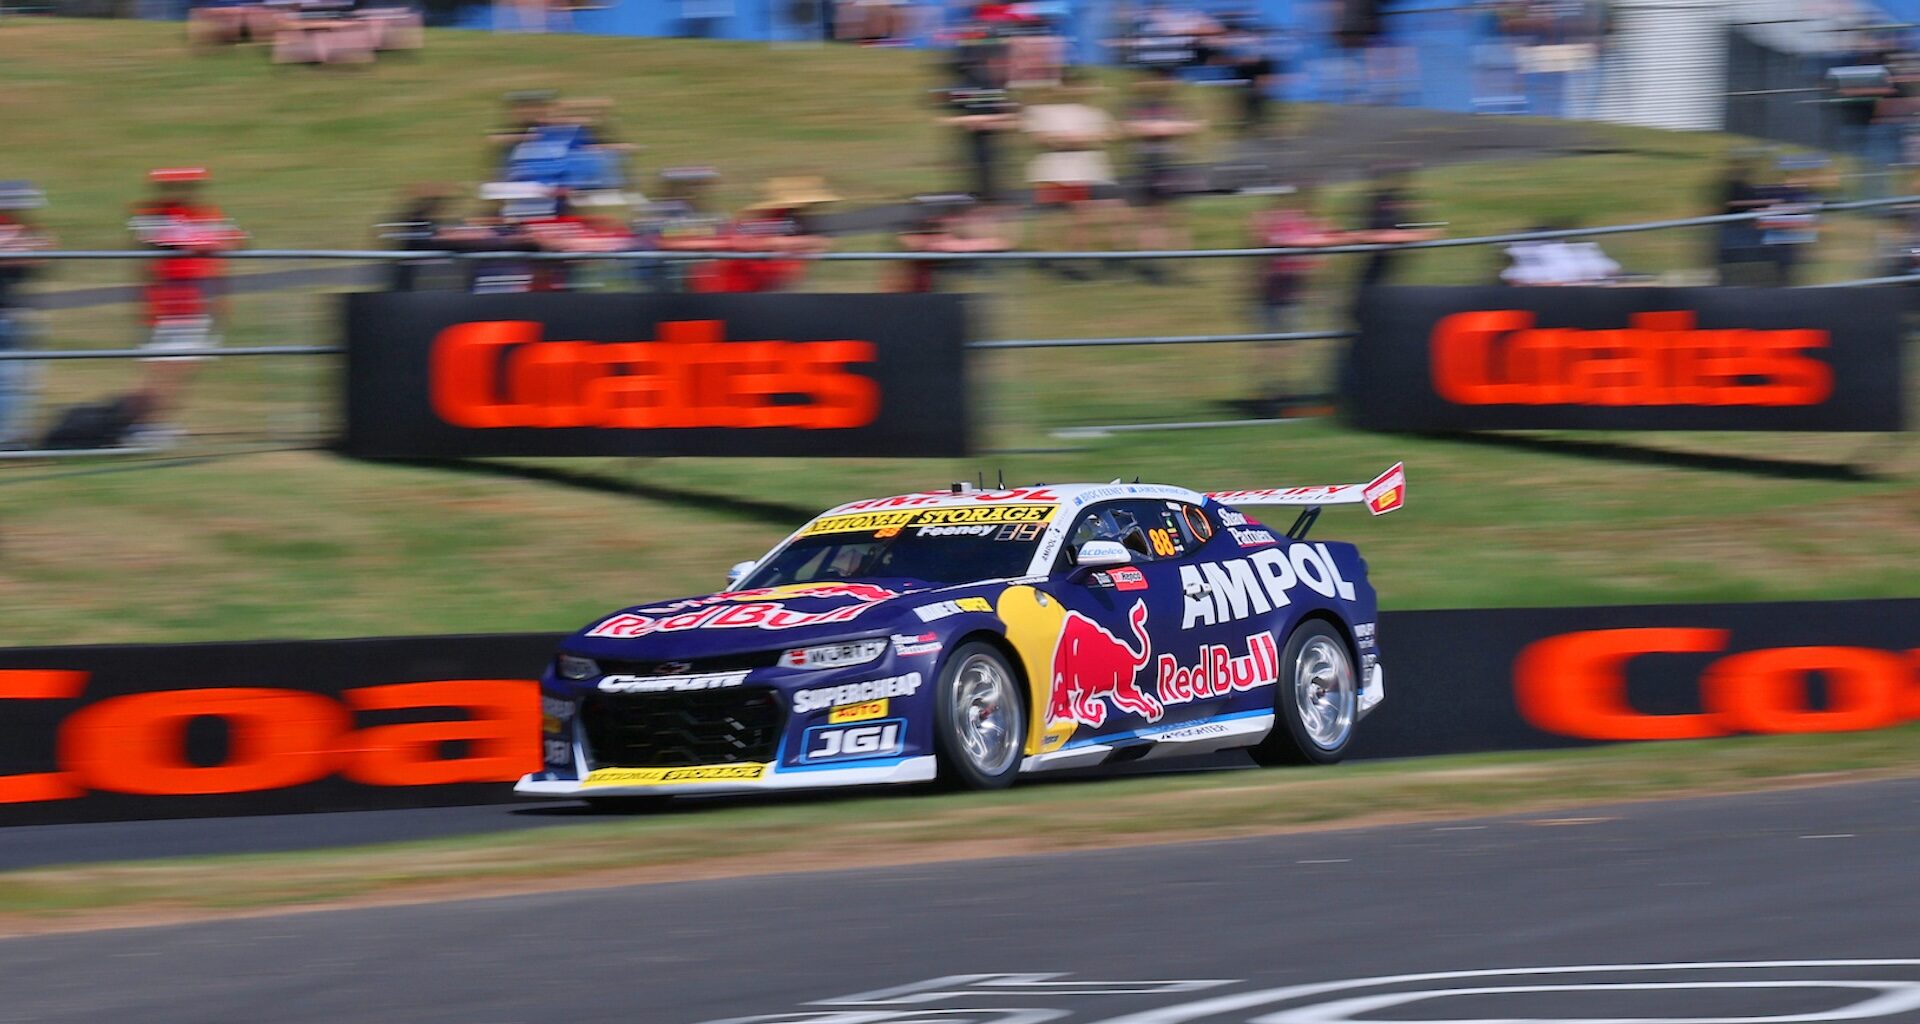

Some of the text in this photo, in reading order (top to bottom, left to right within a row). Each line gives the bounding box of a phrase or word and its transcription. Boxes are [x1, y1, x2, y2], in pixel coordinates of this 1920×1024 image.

[1204, 484, 1355, 498] MPLIFY
[806, 511, 912, 534] NATIONAL
[917, 505, 1050, 525] STORAGE
[916, 524, 997, 538] Feeney
[1217, 507, 1248, 527] Shaw
[1148, 528, 1177, 557] 88
[1179, 542, 1356, 630] AMPOL
[793, 671, 923, 715] SUPERCHEAP
[1512, 626, 1920, 741] Co
[835, 703, 884, 719] AUTO
[808, 723, 900, 759] JGI
